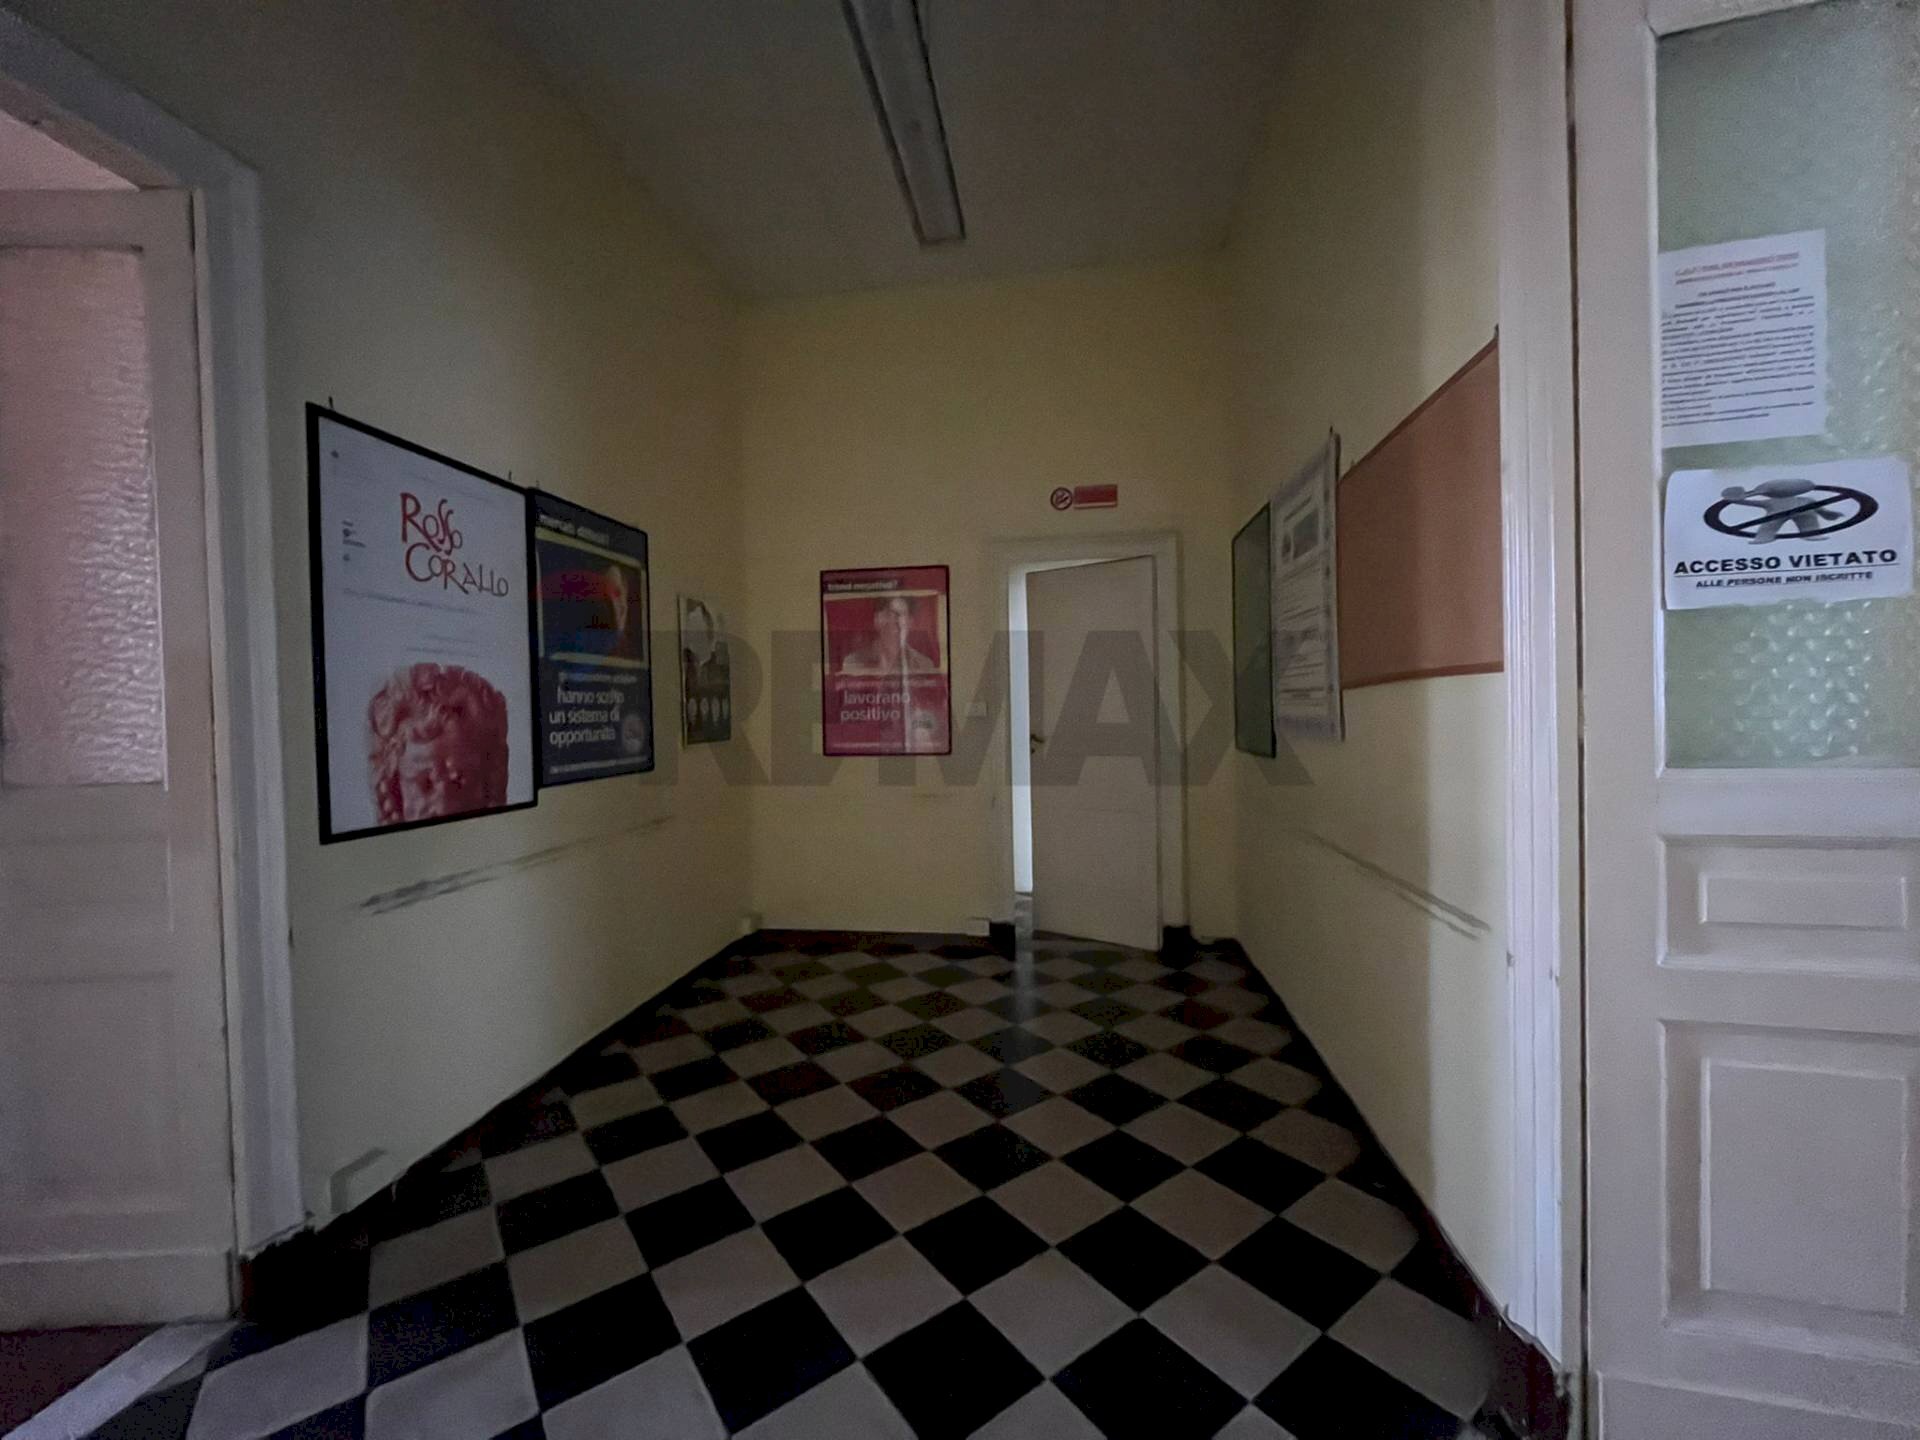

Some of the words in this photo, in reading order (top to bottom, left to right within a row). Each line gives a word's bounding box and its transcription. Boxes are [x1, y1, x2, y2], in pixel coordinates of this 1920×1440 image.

[1674, 556, 1781, 574] ACCESSO
[1789, 549, 1897, 567] VIETATO
[1696, 579, 1724, 588] ALLE
[1727, 576, 1782, 587] PERSONE
[1785, 575, 1811, 584] NON
[1815, 571, 1874, 583] ISCRITTE
[557, 685, 594, 705] hanno
[844, 690, 910, 705] lavorano
[549, 710, 566, 725] un
[610, 705, 620, 723] di
[840, 705, 901, 725] positivo
